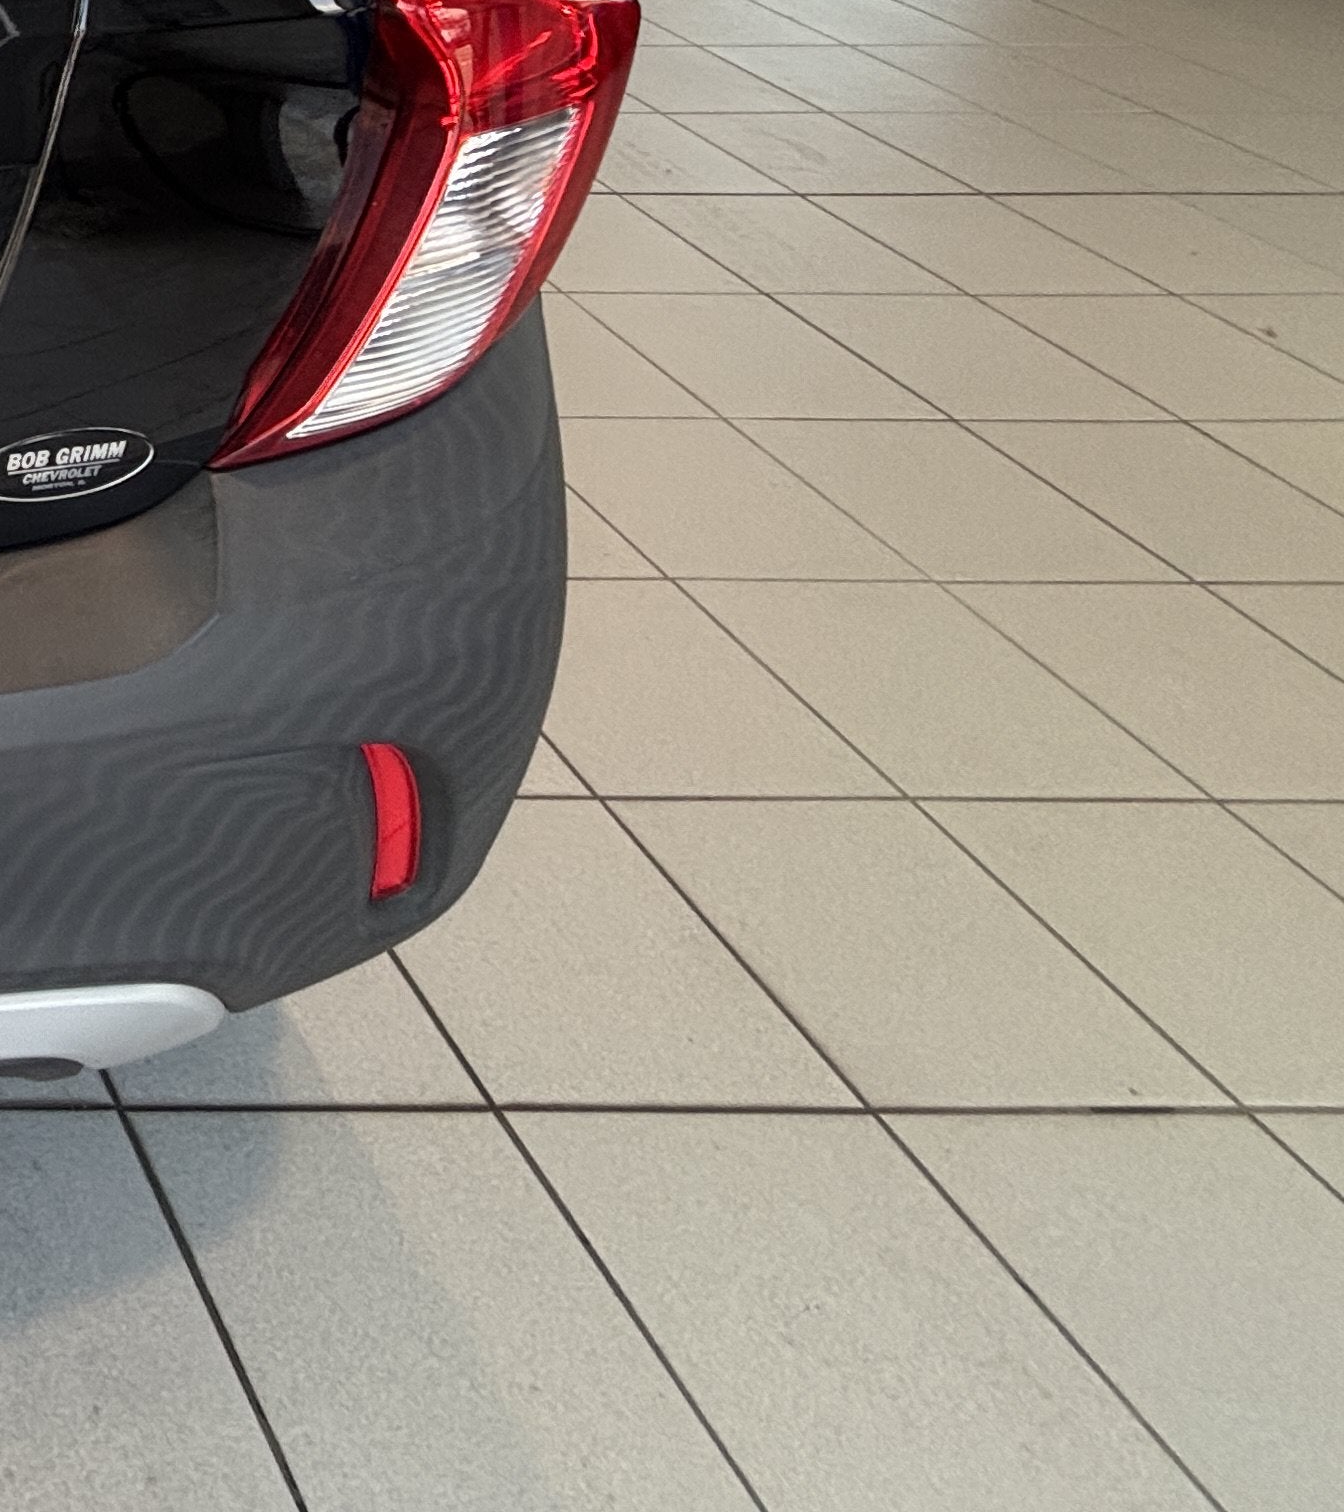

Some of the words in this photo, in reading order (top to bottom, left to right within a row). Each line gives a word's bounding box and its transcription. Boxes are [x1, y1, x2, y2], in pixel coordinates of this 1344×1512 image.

[6, 450, 51, 472] BOB
[55, 440, 128, 465] GRIMM
[22, 465, 103, 486] CHEVROLET
